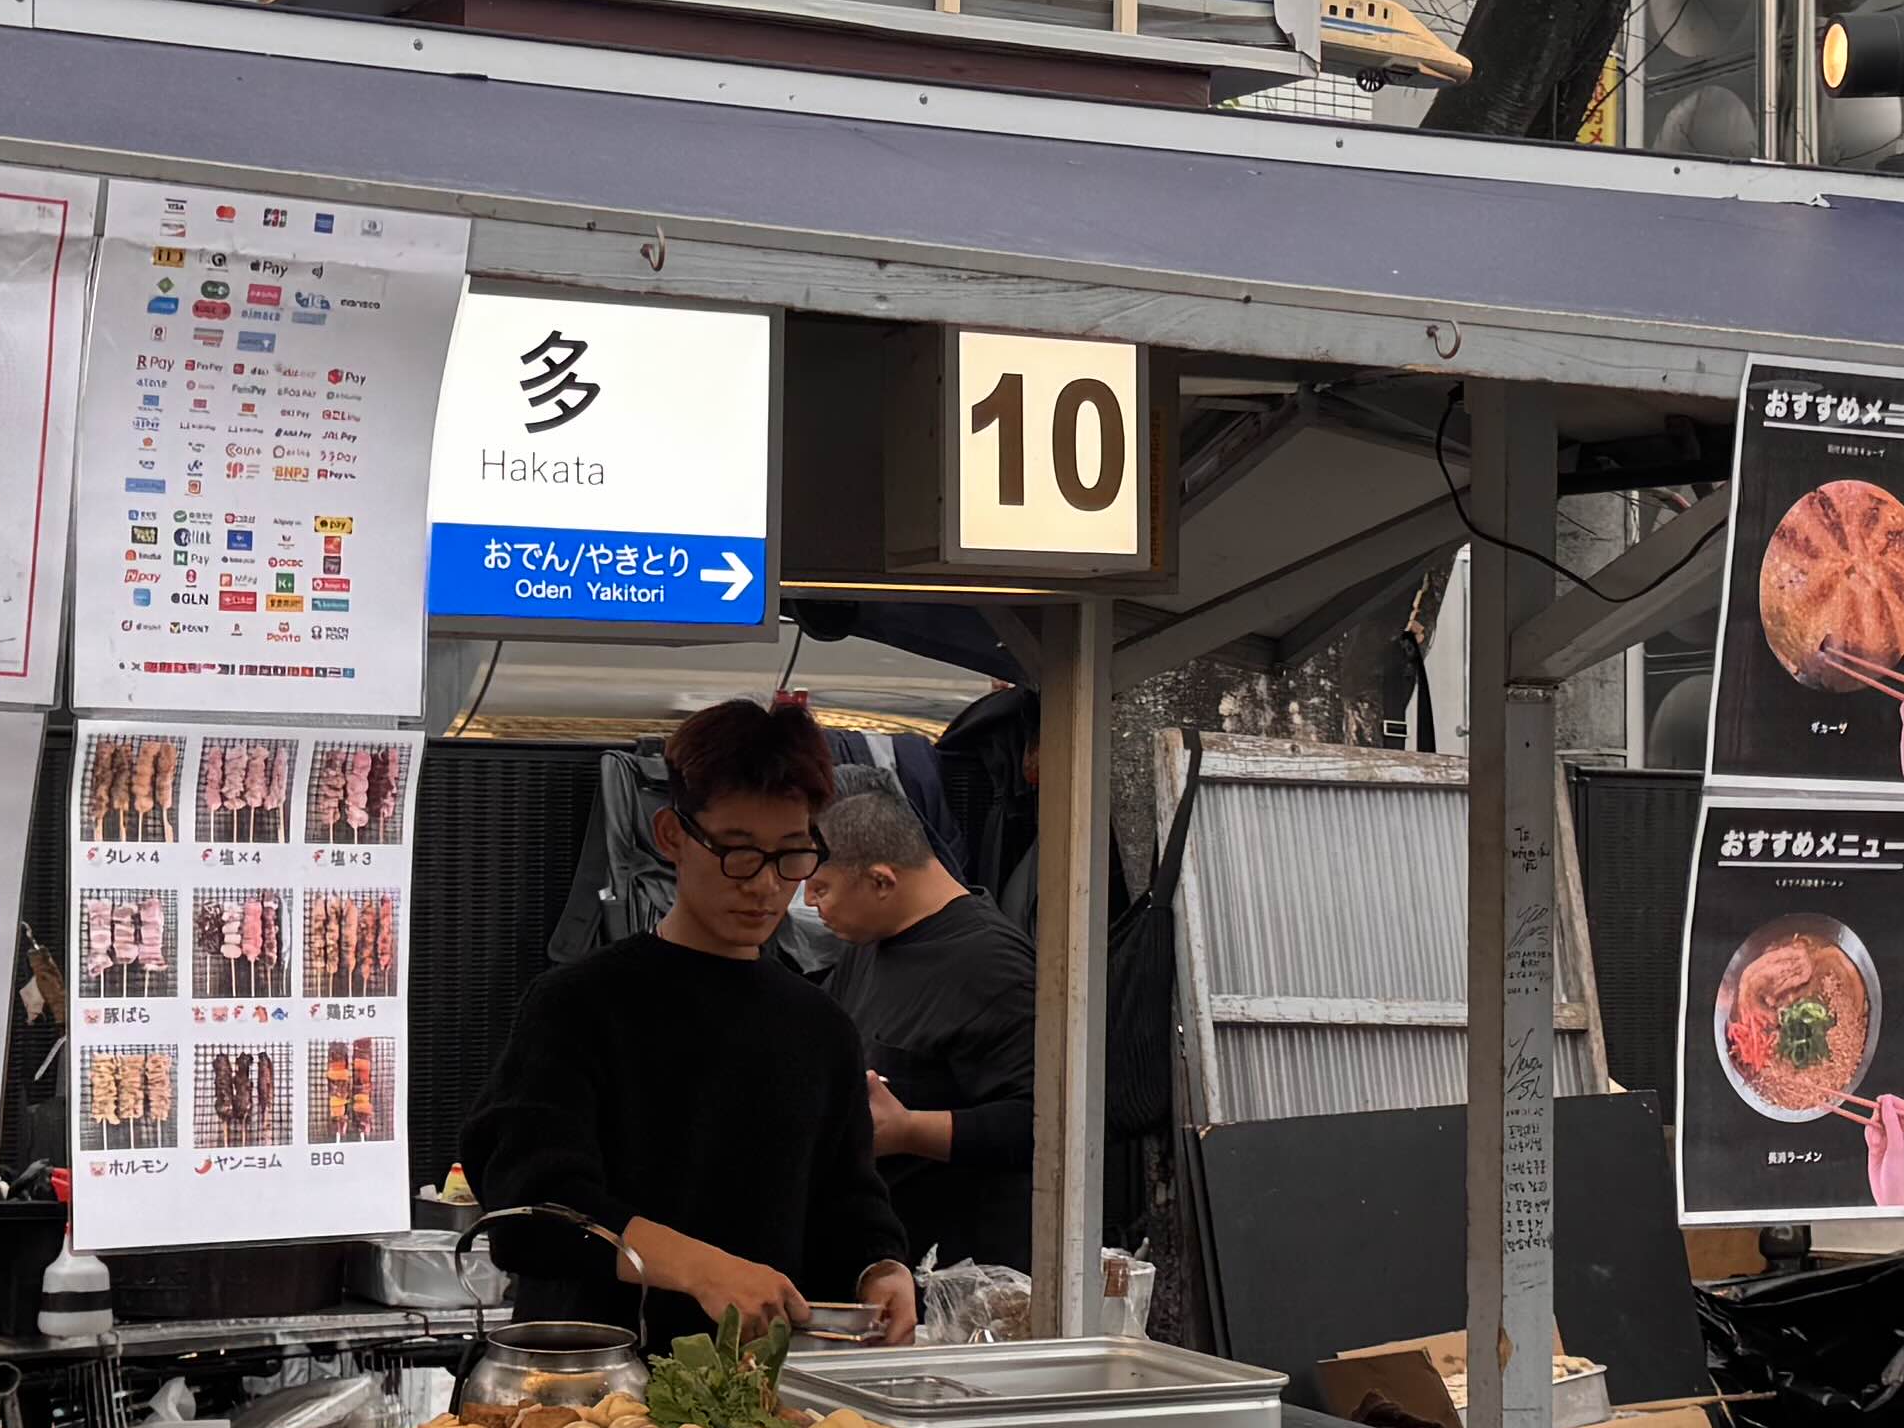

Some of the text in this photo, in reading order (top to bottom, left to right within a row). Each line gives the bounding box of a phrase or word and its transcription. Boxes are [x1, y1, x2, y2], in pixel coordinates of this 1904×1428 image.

[519, 329, 602, 435] 多
[971, 371, 1126, 513] 10
[481, 449, 606, 487] Hakata
[483, 537, 690, 577] おでん/やきとり
[515, 578, 665, 605] Oden Yakitori
[1720, 830, 1904, 858] おすすめメニュー
[108, 1159, 169, 1176] ホルモン
[214, 1153, 282, 1171] ヤンニョム
[311, 1151, 345, 1166] BBQ
